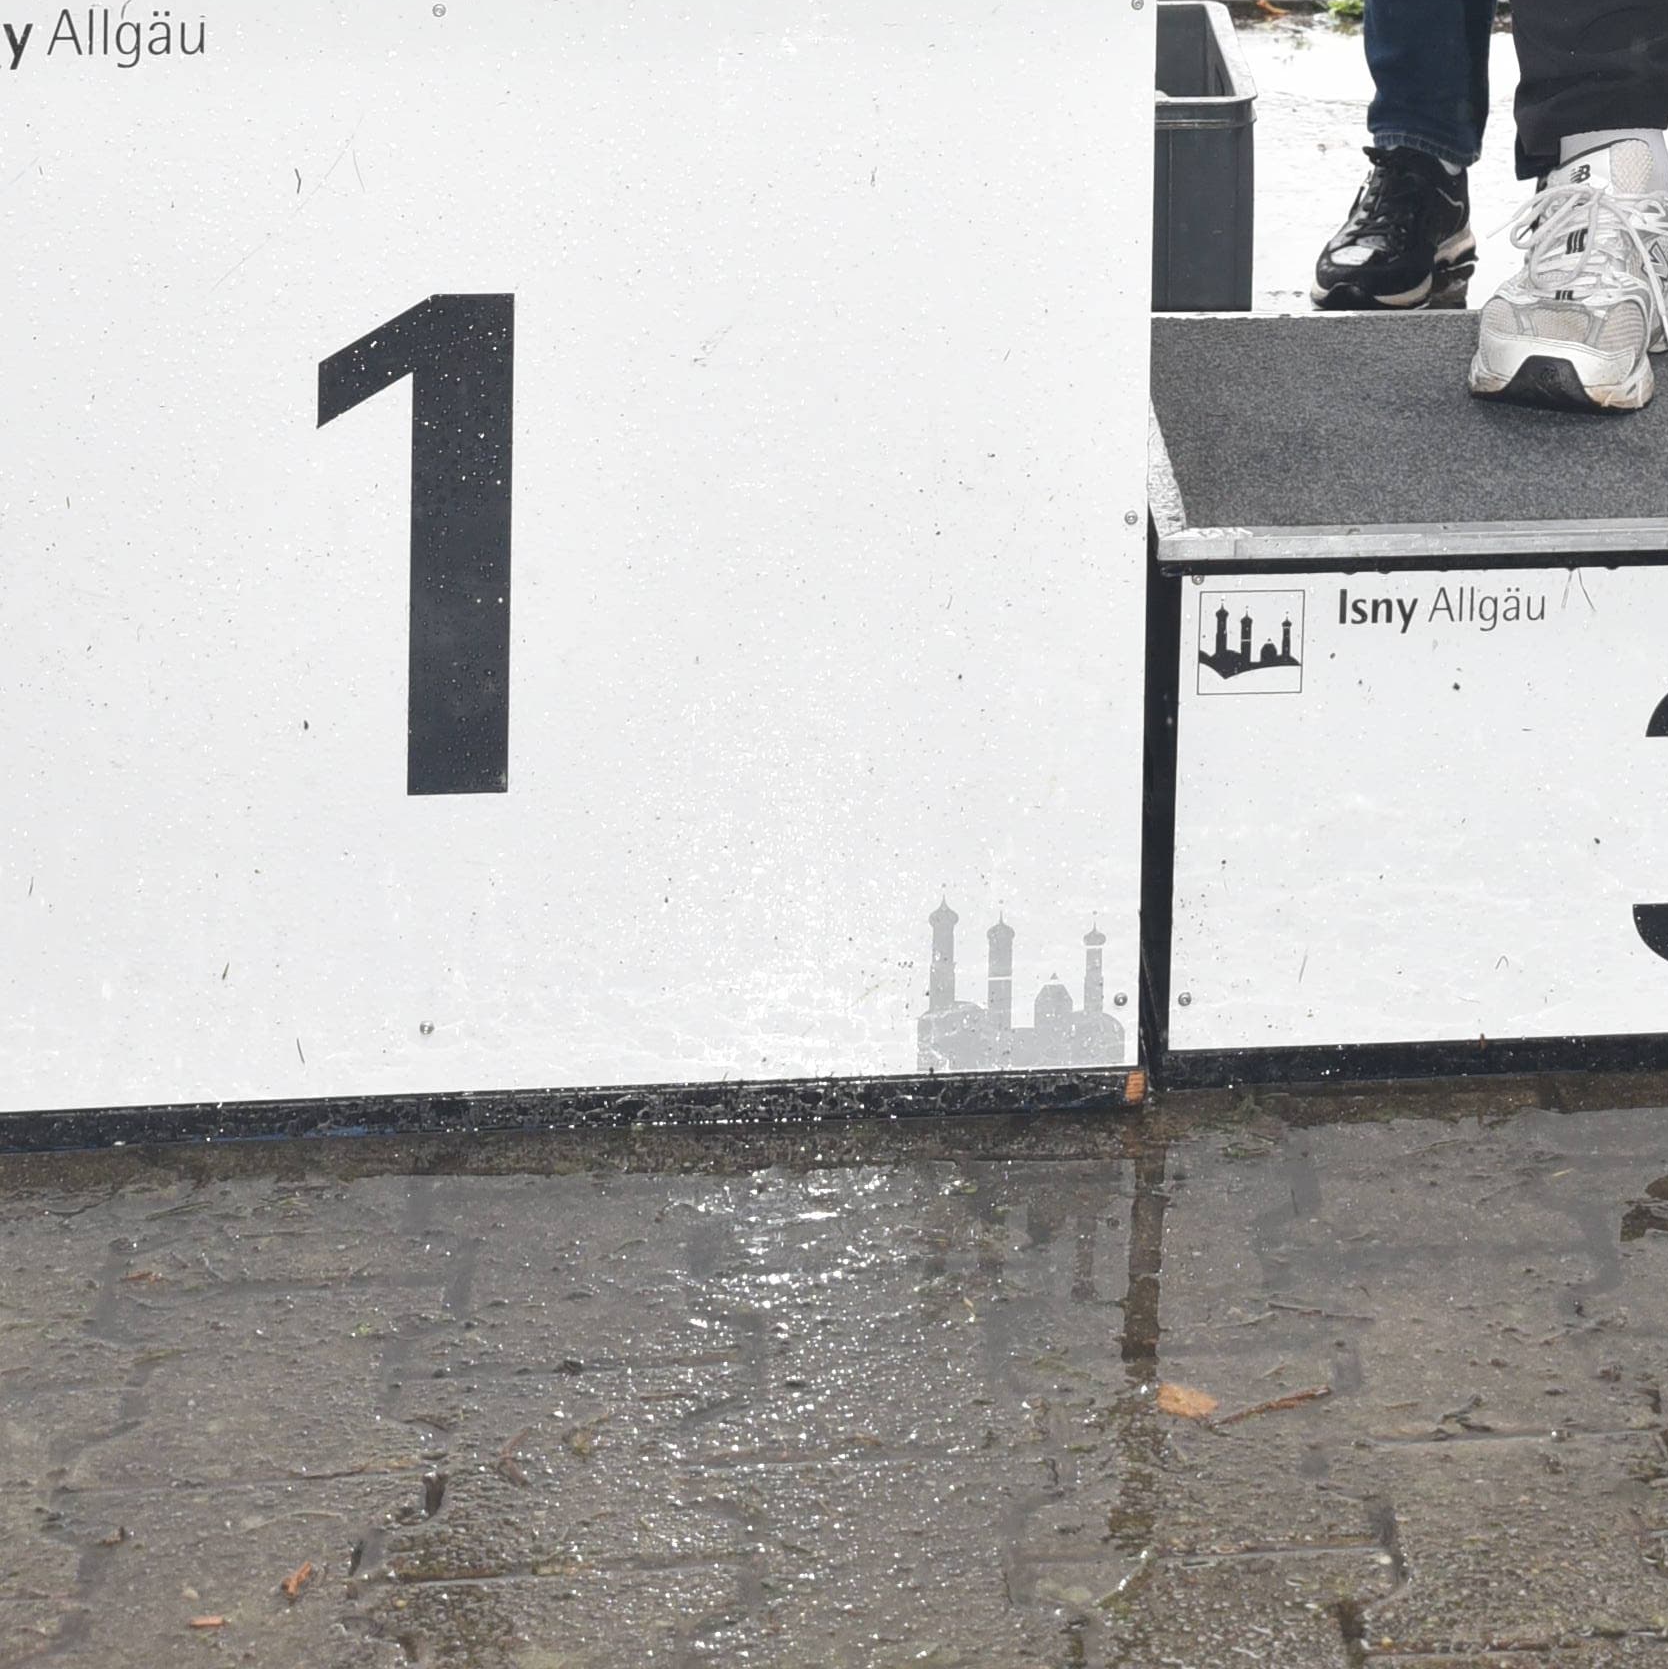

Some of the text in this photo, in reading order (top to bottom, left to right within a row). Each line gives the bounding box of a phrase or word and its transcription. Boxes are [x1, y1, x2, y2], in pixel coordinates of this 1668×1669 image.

[47, 8, 206, 69] Allgäu
[317, 292, 516, 796] 1
[1338, 586, 1546, 634] Isny Allgäu
